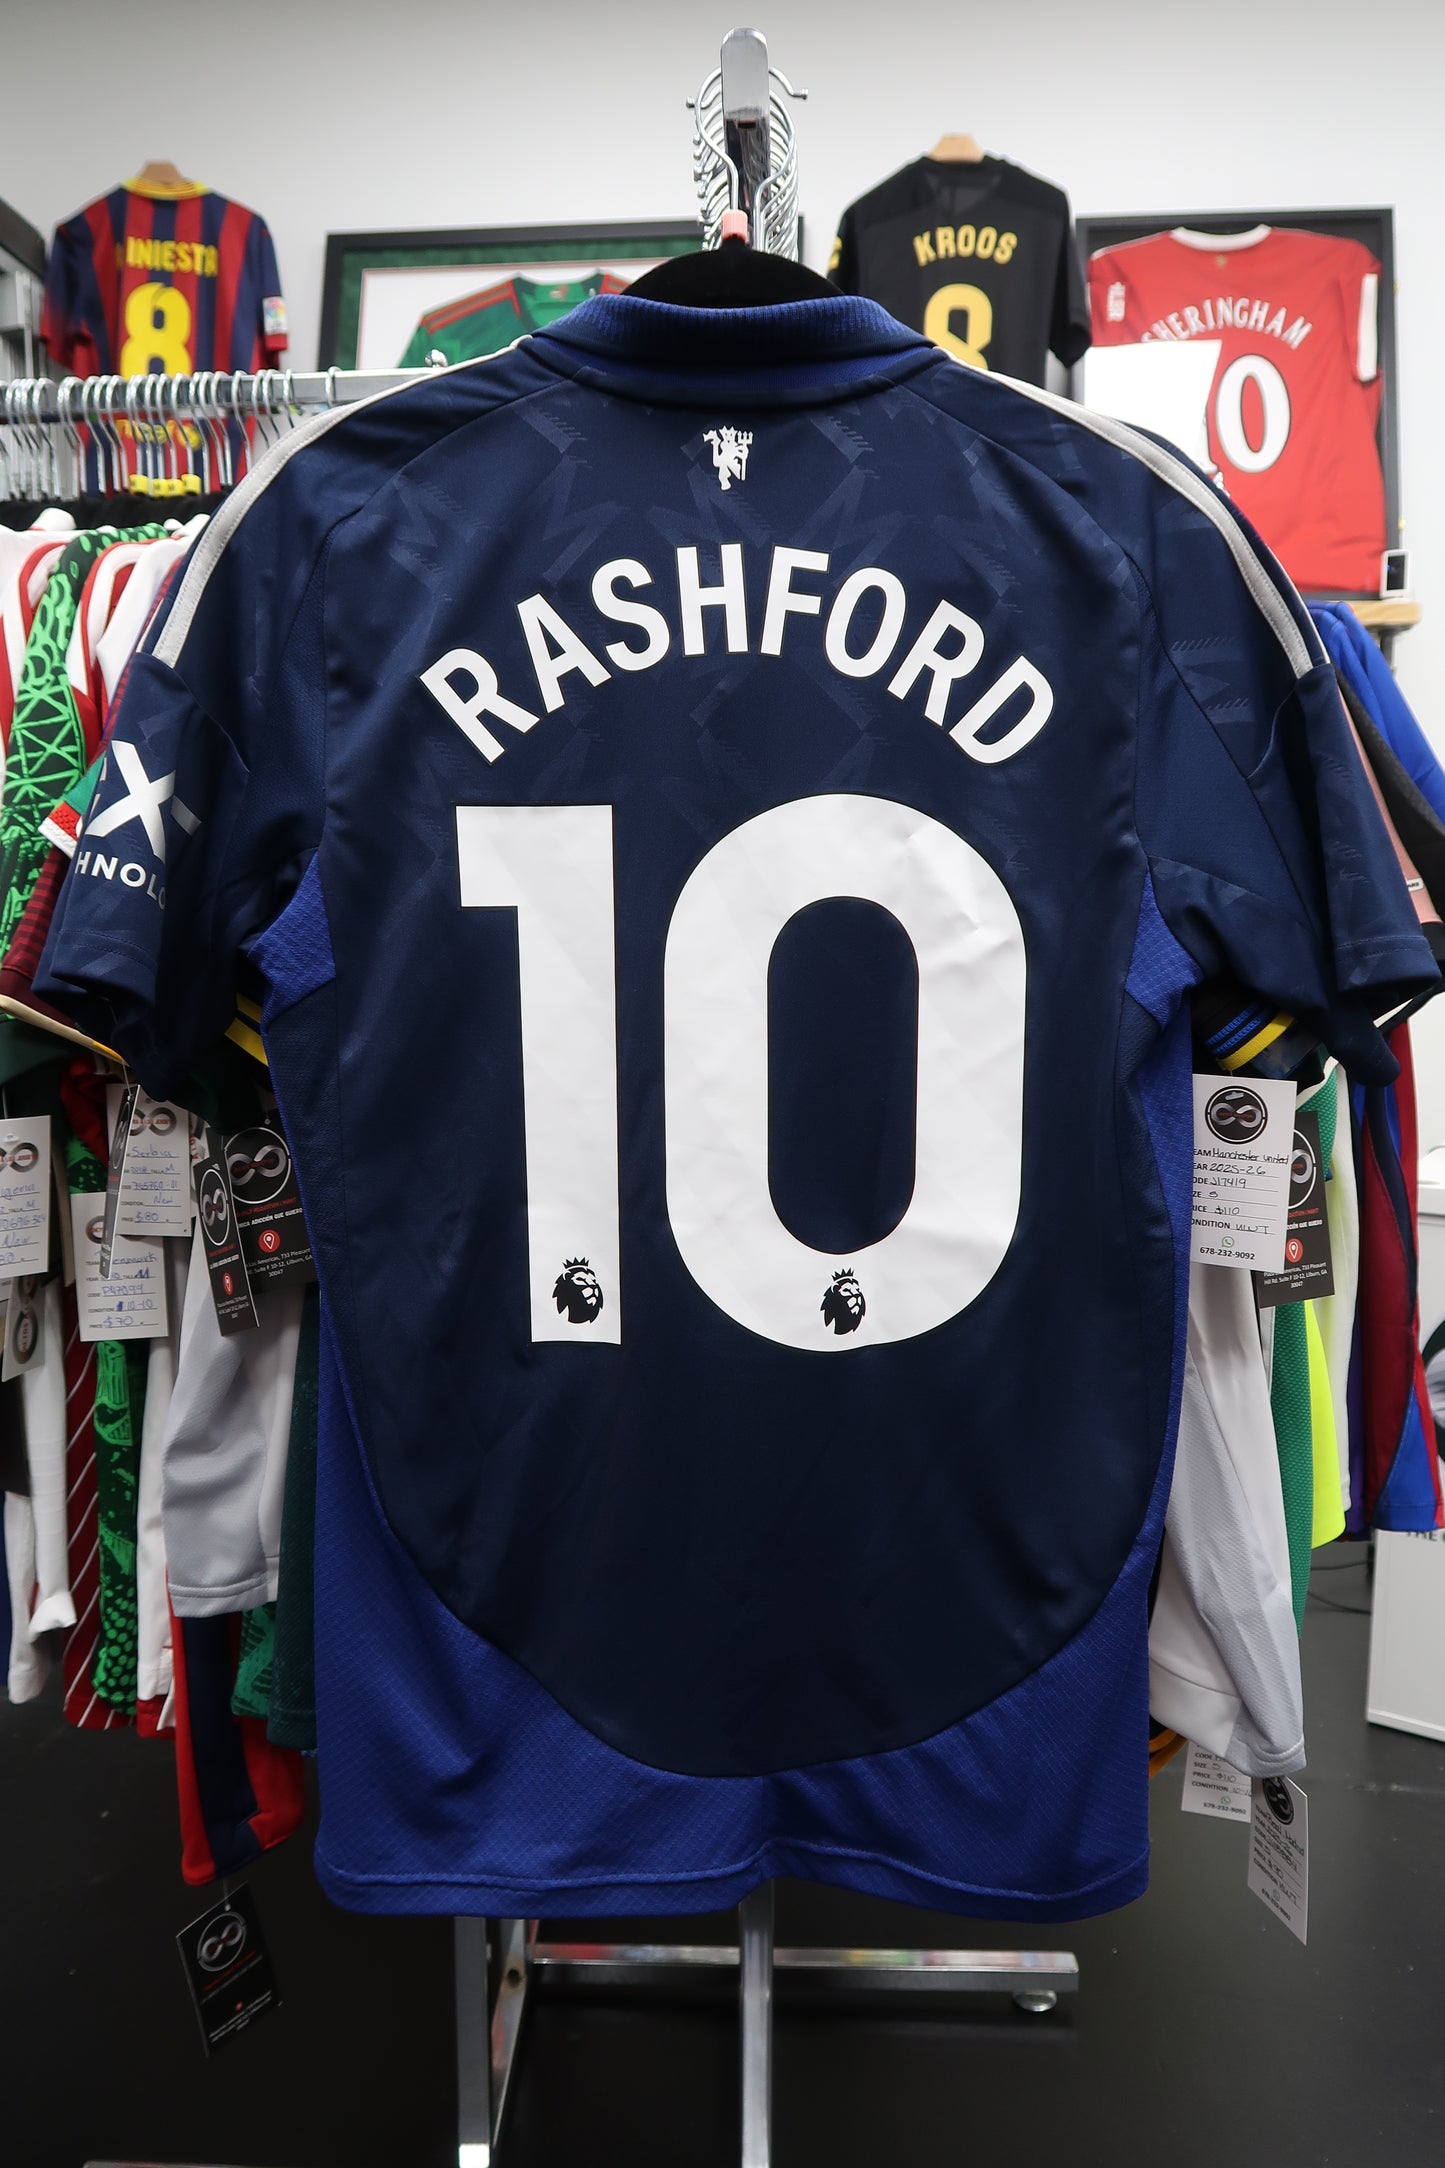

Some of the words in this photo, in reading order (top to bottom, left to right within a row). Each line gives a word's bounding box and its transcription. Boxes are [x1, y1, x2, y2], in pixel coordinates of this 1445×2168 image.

[913, 224, 1018, 267] KROOS
[120, 281, 191, 381] 8
[923, 283, 992, 371] 8
[1205, 353, 1292, 474] 0
[417, 541, 1056, 766] RASHFORD
[455, 794, 1028, 1352] 10
[95, 1251, 158, 1265] enmark
[1199, 1246, 1256, 1261] 678-232-9092
[1192, 1771, 1211, 1779] PRICE
[1194, 1752, 1212, 1760] CODE
[1191, 1780, 1229, 1792] CONDITION
